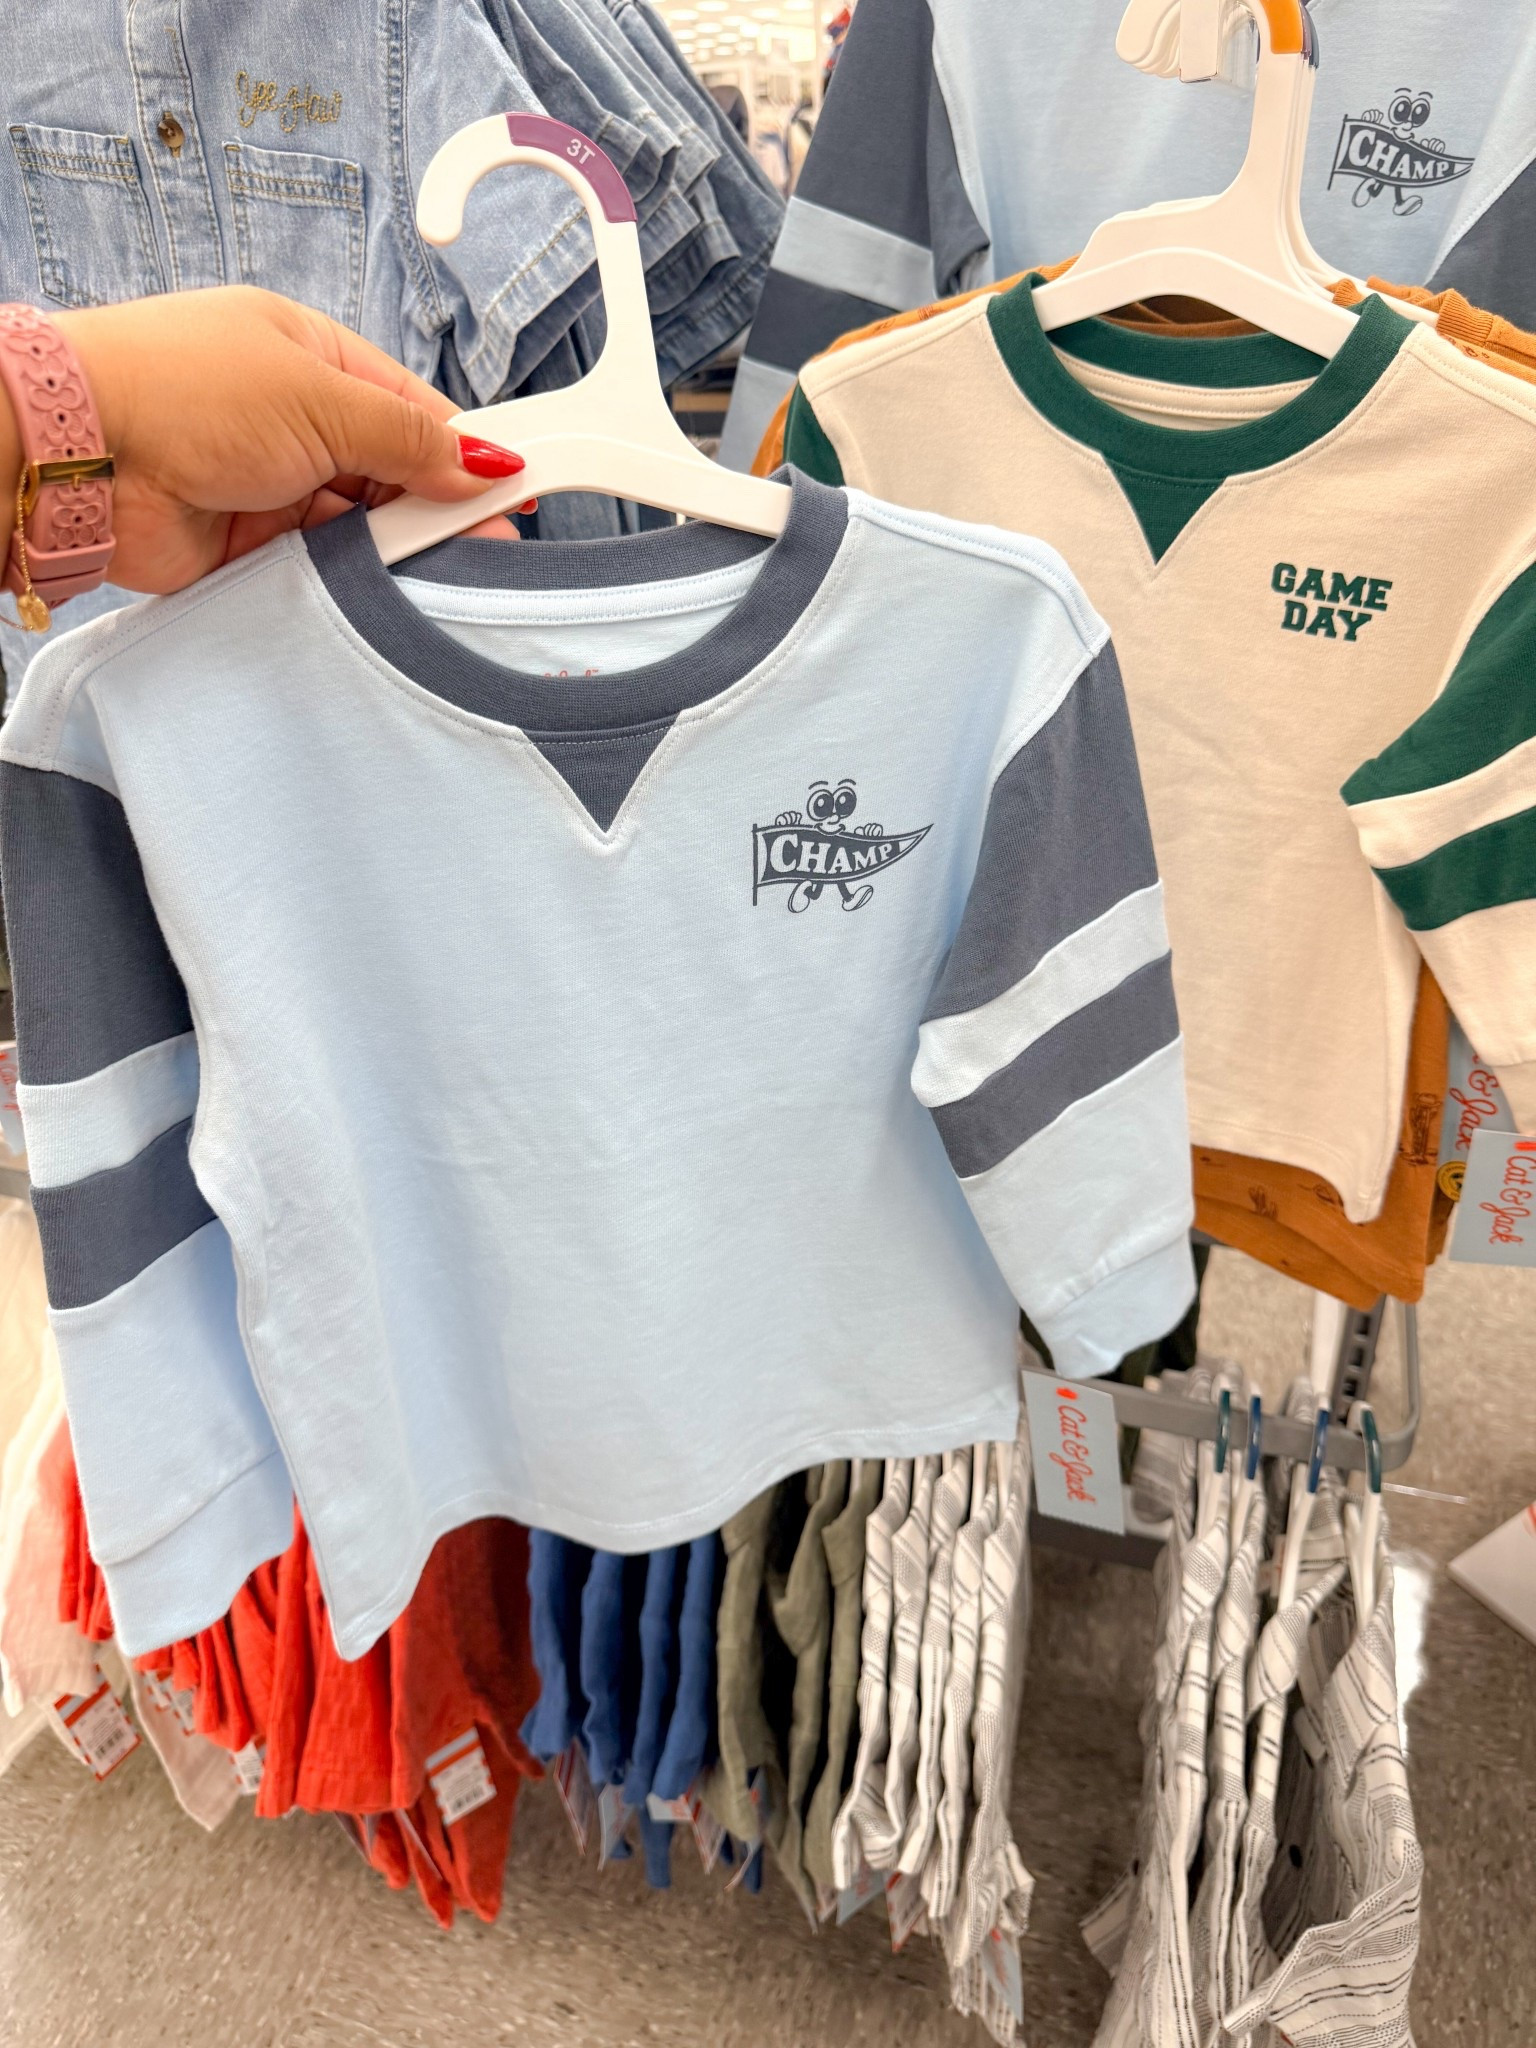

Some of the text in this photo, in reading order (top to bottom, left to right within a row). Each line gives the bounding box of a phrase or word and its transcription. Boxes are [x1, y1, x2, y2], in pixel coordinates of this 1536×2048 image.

[566, 138, 596, 165] 3T
[1348, 129, 1450, 180] CHAMP
[1271, 562, 1393, 612] GAME
[1281, 599, 1373, 643] DAY
[769, 833, 893, 875] CHAMP
[1479, 1155, 1536, 1245] Cat & Jack
[1049, 1405, 1096, 1503] Cat & Jack
